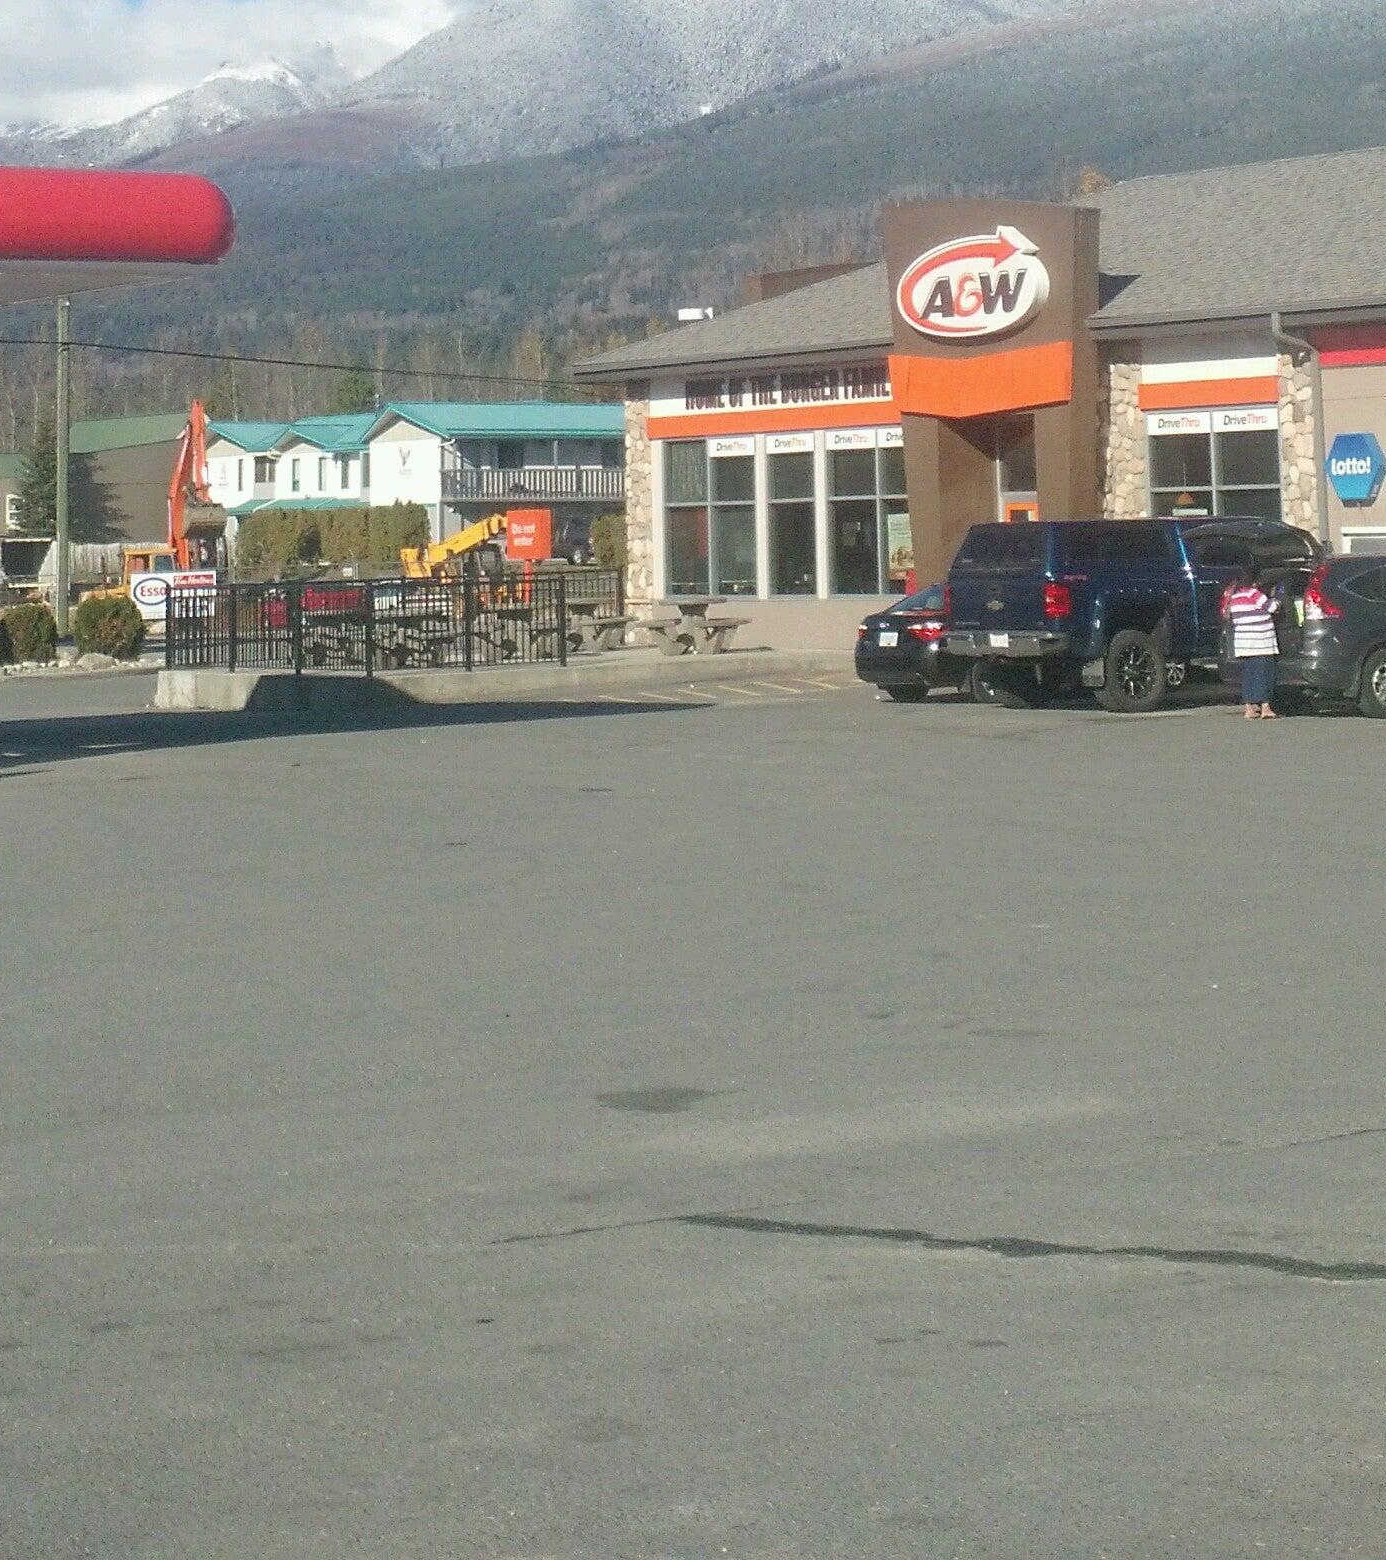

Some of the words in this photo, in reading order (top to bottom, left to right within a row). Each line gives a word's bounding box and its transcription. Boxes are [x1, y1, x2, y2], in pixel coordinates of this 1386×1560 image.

[918, 268, 1027, 320] A&W
[685, 378, 725, 410] HOME
[729, 377, 747, 408] OF
[750, 374, 777, 406] THE
[780, 369, 840, 404] BURGER
[1330, 456, 1372, 476] lotto!
